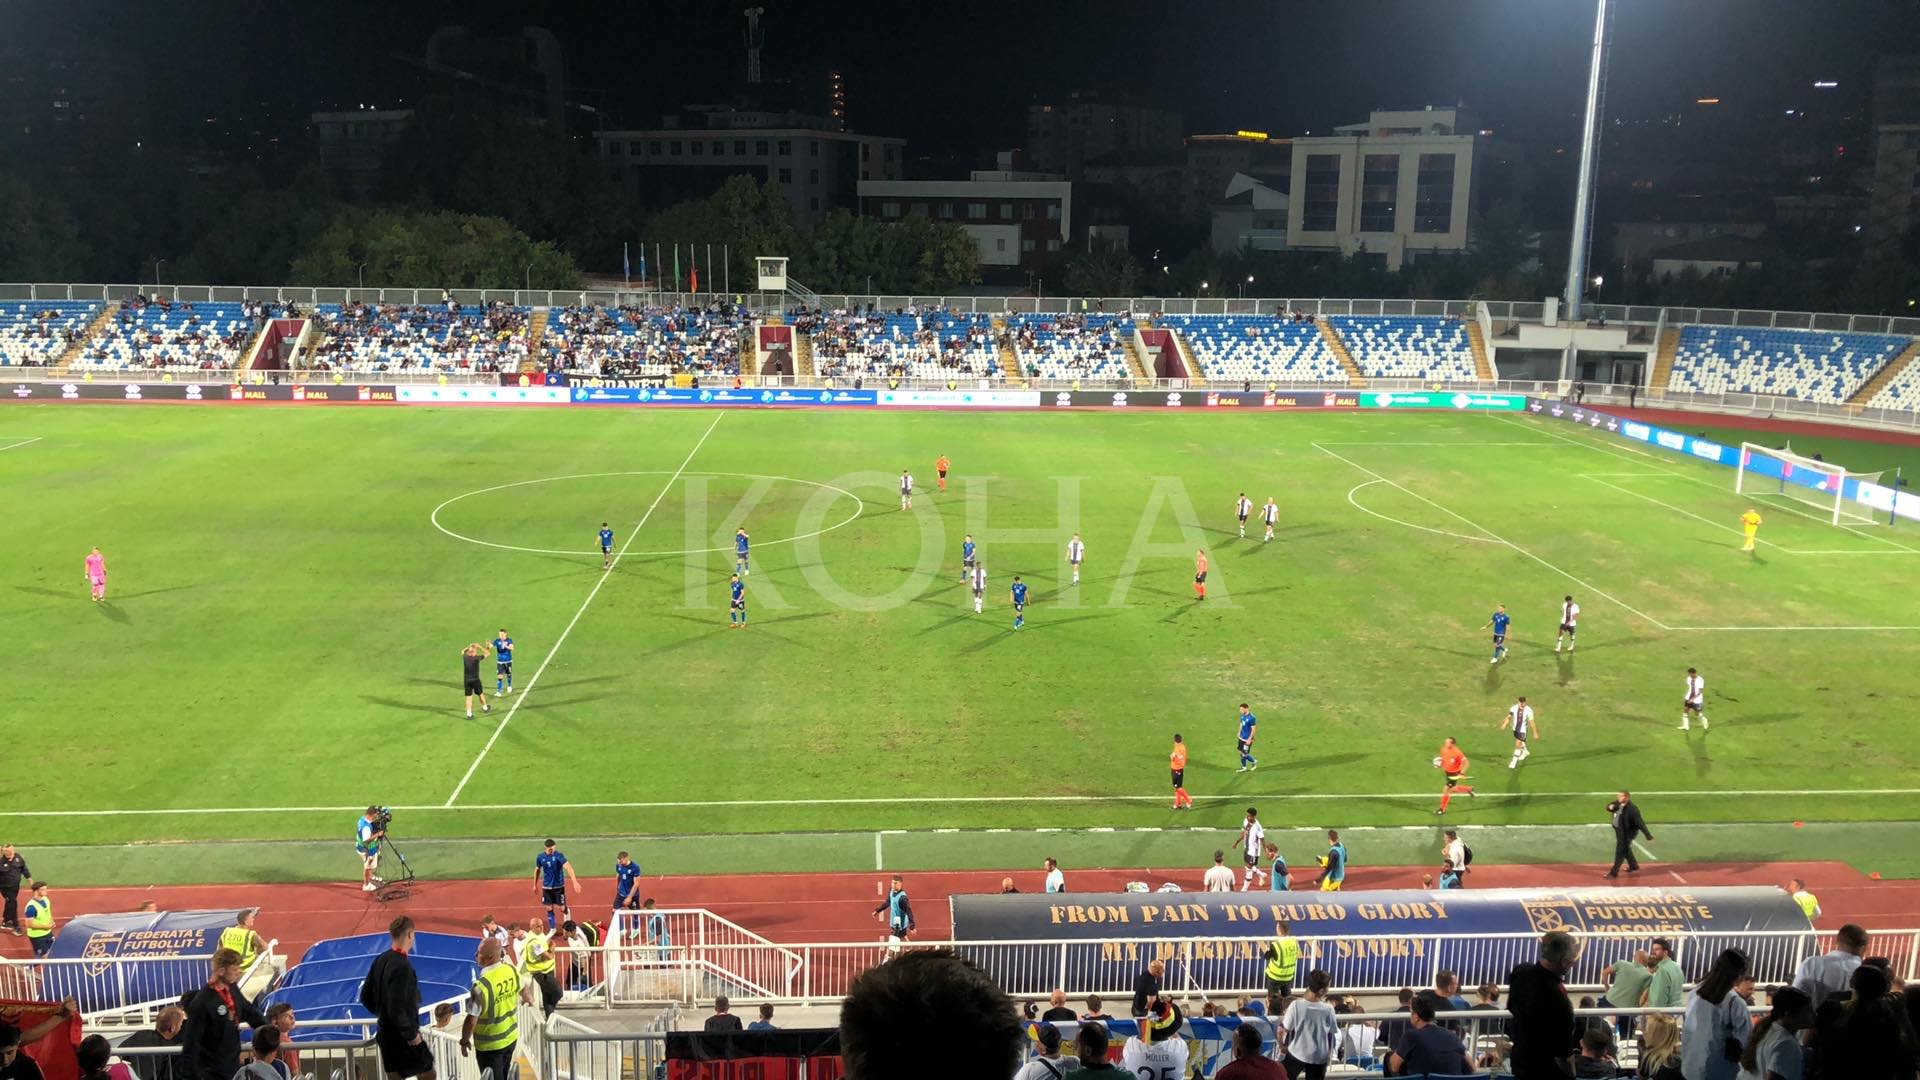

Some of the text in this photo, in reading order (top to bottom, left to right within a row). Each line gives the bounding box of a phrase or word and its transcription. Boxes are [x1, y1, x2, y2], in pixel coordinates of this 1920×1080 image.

[244, 391, 267, 399] MALL
[306, 391, 329, 400] MALL
[371, 392, 394, 400] MALL
[1276, 398, 1297, 406] MALL
[1336, 398, 1357, 406] MALL
[1050, 901, 1449, 924] FROM PAIN TO EURO GLORY
[1585, 905, 1714, 920] FUTBOLLIT E
[127, 929, 205, 940] FEDERATA E
[123, 938, 205, 950] FUTBOLLIT E
[1101, 942, 1139, 961] MY
[1336, 938, 1425, 958] STORY
[496, 977, 514, 996] 227
[1145, 1052, 1170, 1061] MÜLLER
